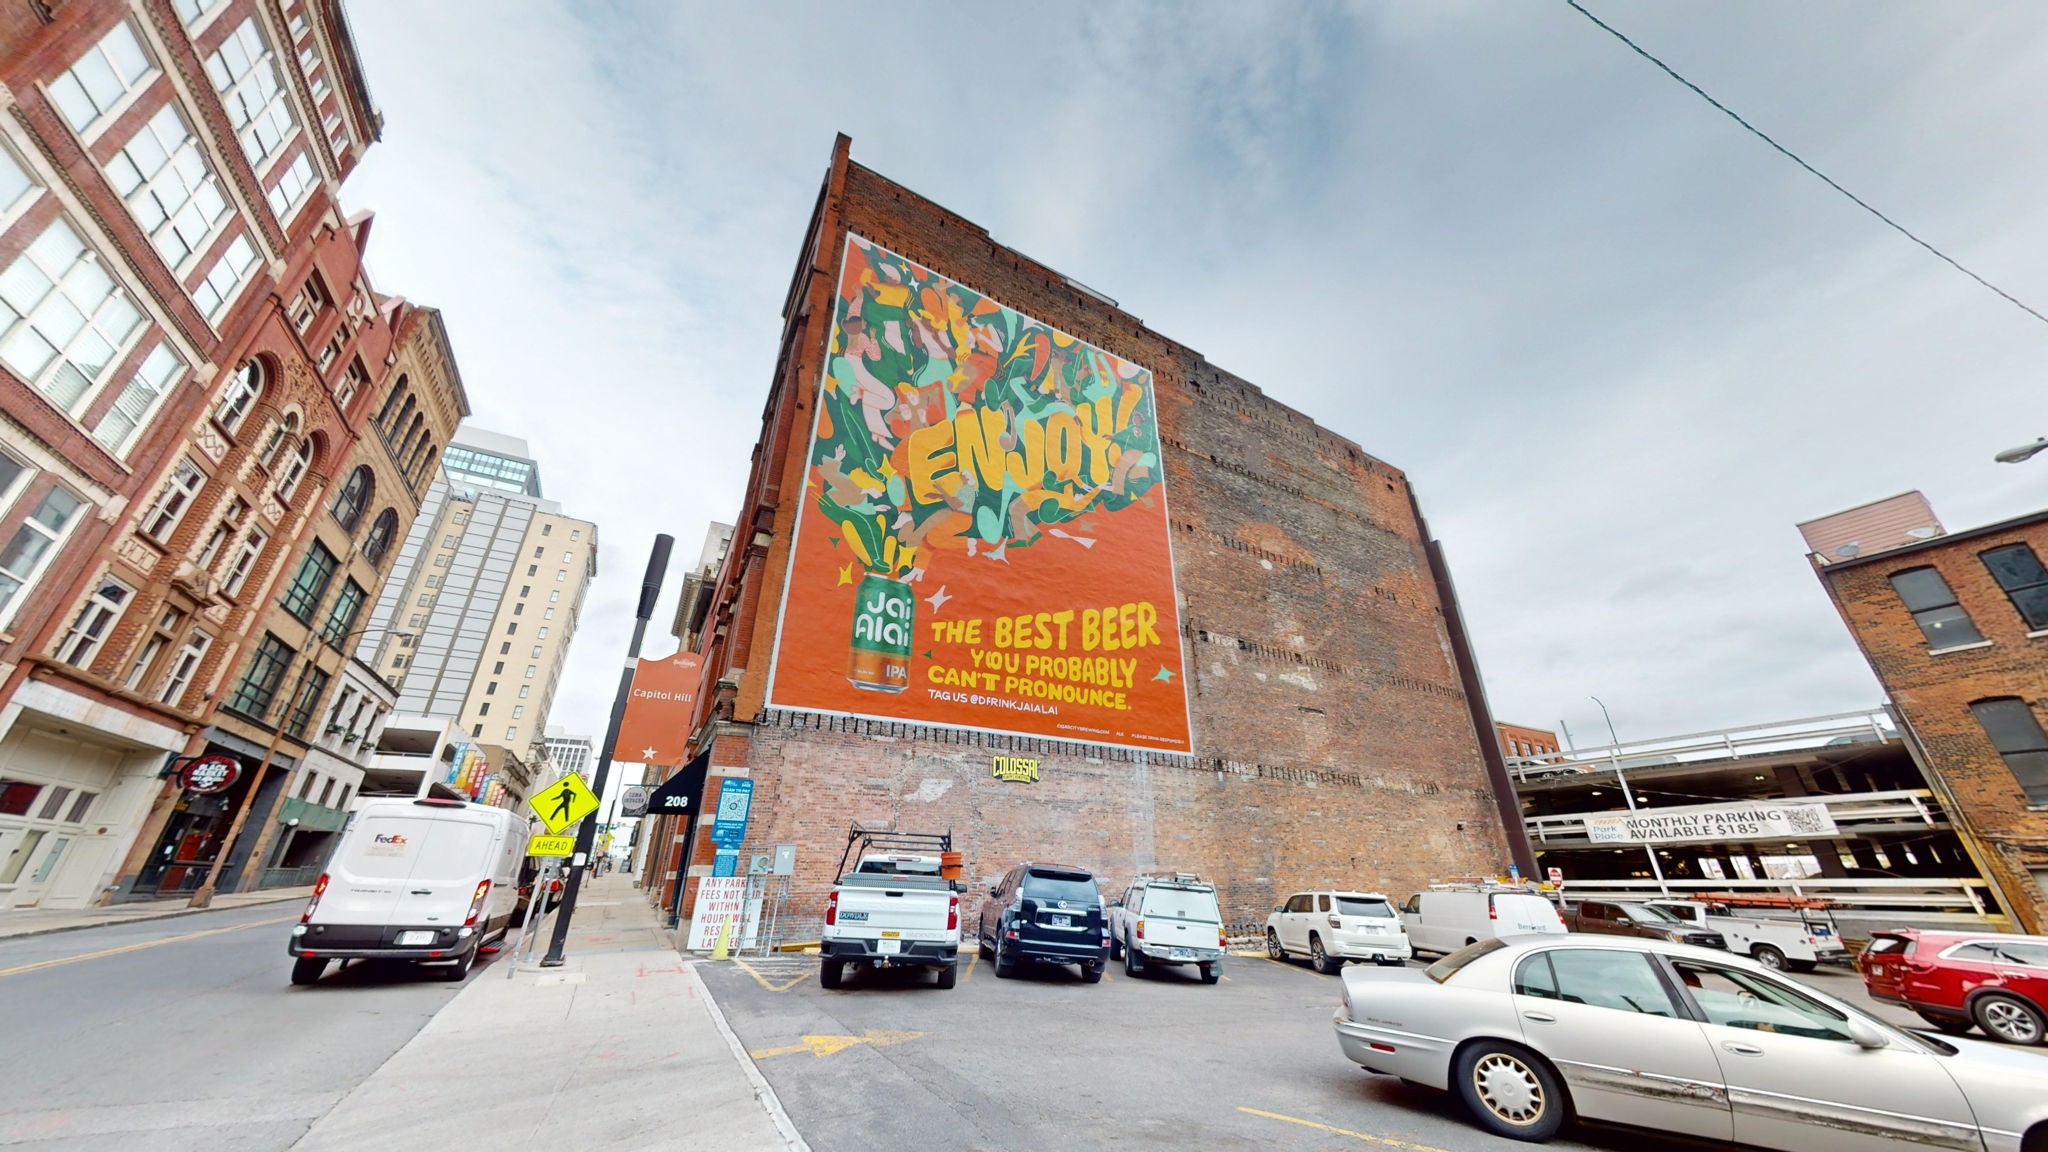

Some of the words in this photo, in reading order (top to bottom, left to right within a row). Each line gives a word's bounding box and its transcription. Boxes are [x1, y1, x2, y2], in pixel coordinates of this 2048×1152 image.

[908, 383, 1143, 505] ENJOY!
[867, 592, 911, 620] Jai
[855, 613, 909, 647] Alai
[931, 619, 983, 644] THE
[995, 609, 1074, 650] BEST
[1082, 601, 1161, 651] BEER
[886, 664, 907, 679] IPA
[970, 648, 1020, 674] YOU
[1026, 655, 1137, 688] PROBABLY
[633, 688, 671, 701] Capitol
[674, 693, 692, 703] Hill
[928, 689, 950, 700] TAG
[953, 692, 968, 703] US
[1005, 676, 1132, 711] PRONOUNCE.
[664, 795, 689, 807] 208
[1626, 815, 1699, 830] MONTHLY
[1704, 810, 1781, 824] PARKING
[1593, 825, 1617, 833] Park
[1594, 832, 1624, 840] Place
[1630, 825, 1711, 840] AVAILABLE
[1717, 823, 1759, 836] $185
[375, 834, 408, 845] FedEx
[536, 841, 568, 851] AHEAD
[706, 878, 723, 888] ANY
[725, 879, 760, 888] PARKG
[701, 890, 721, 900] FEES
[724, 890, 740, 900] NOT
[709, 902, 740, 911] WITHIN
[704, 926, 737, 935] REST
[702, 938, 718, 948] LAT
